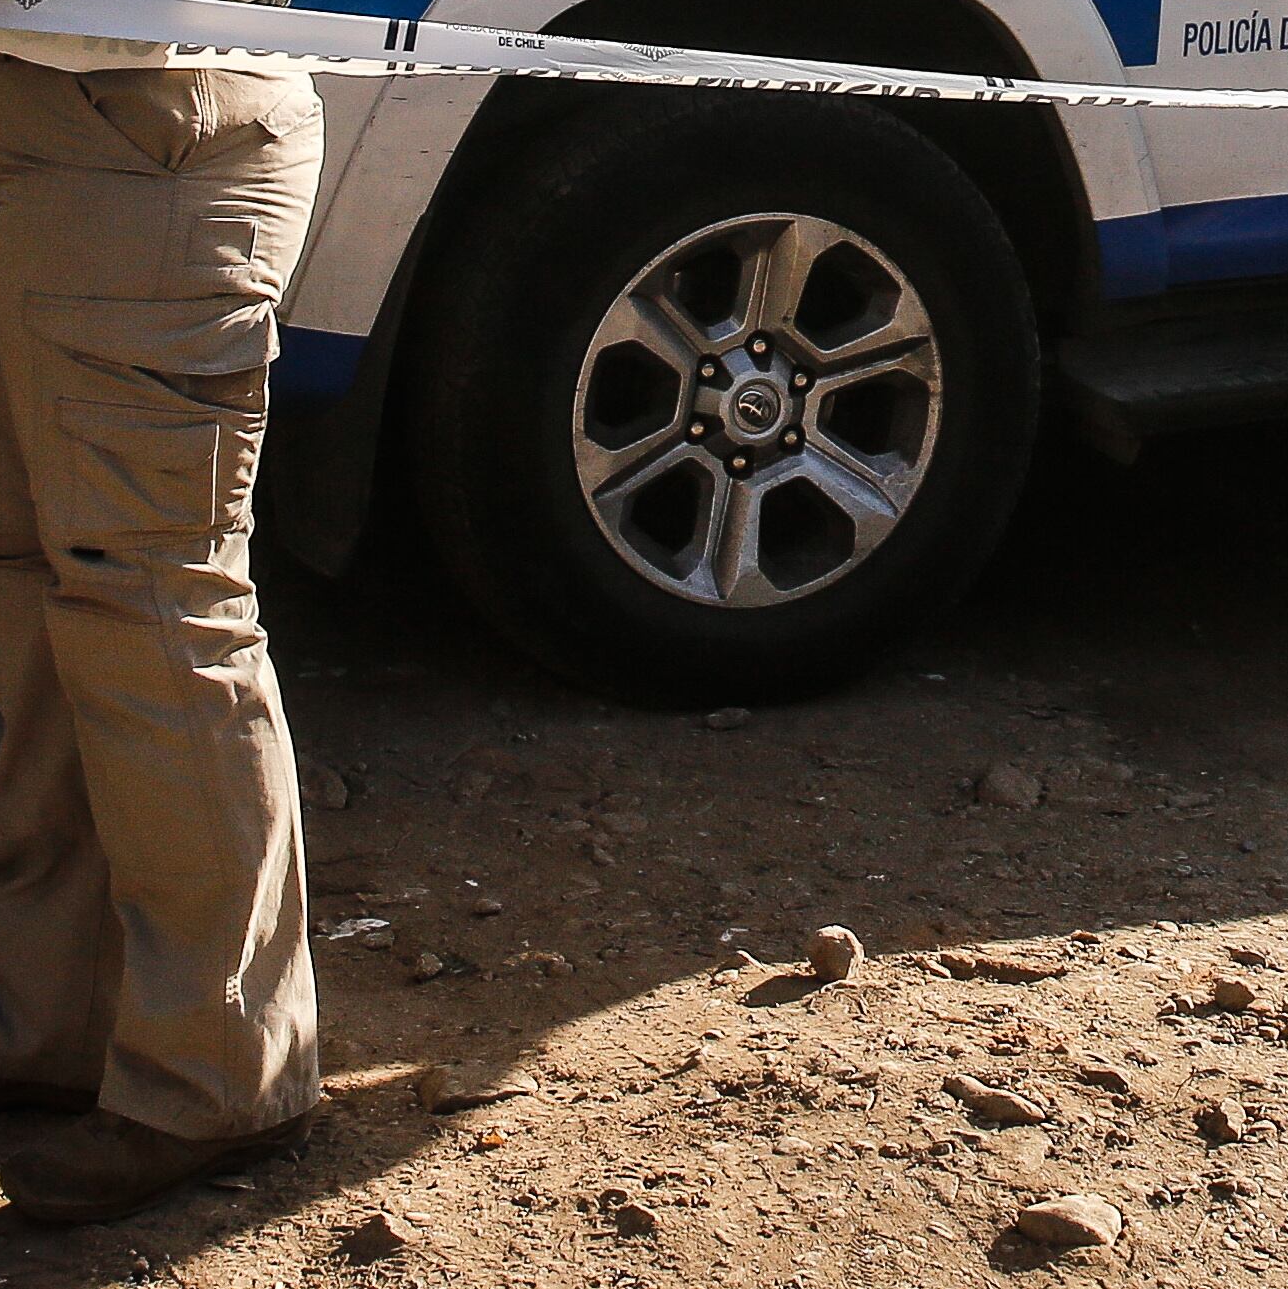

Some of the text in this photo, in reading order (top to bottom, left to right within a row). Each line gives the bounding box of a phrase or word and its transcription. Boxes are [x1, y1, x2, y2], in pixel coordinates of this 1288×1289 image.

[498, 36, 545, 50] DE CHILE
[1183, 10, 1272, 57] POLICÍA
